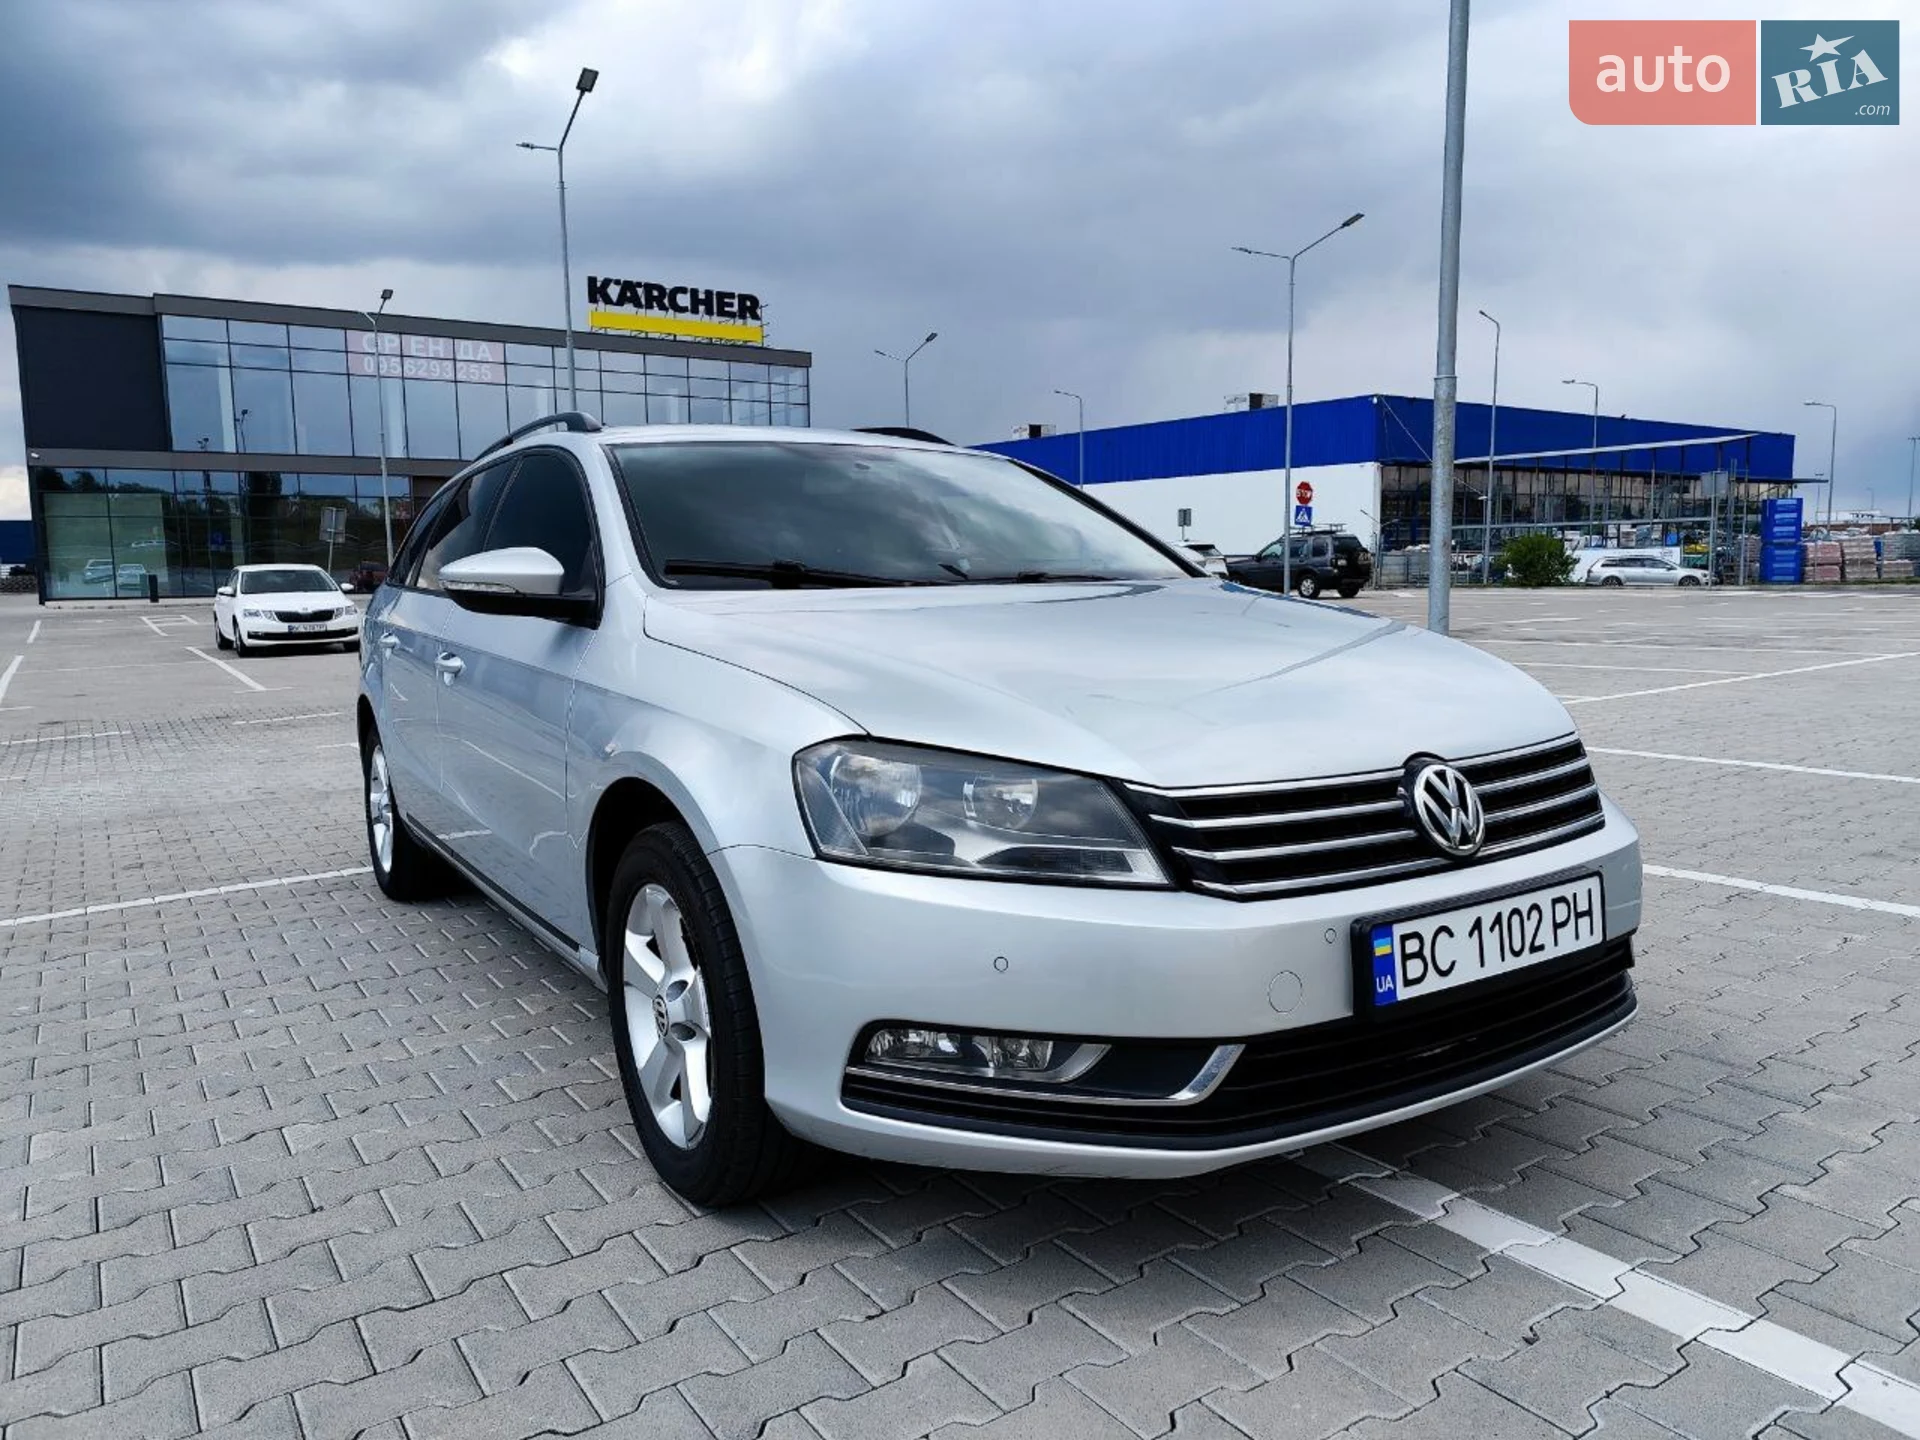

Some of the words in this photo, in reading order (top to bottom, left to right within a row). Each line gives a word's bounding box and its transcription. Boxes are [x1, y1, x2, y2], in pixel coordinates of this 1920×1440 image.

[587, 276, 762, 321] KÄRCHER
[1400, 925, 1457, 988] BC
[1468, 902, 1545, 968] 1102
[1551, 888, 1594, 947] PH
[1375, 974, 1394, 993] UA
